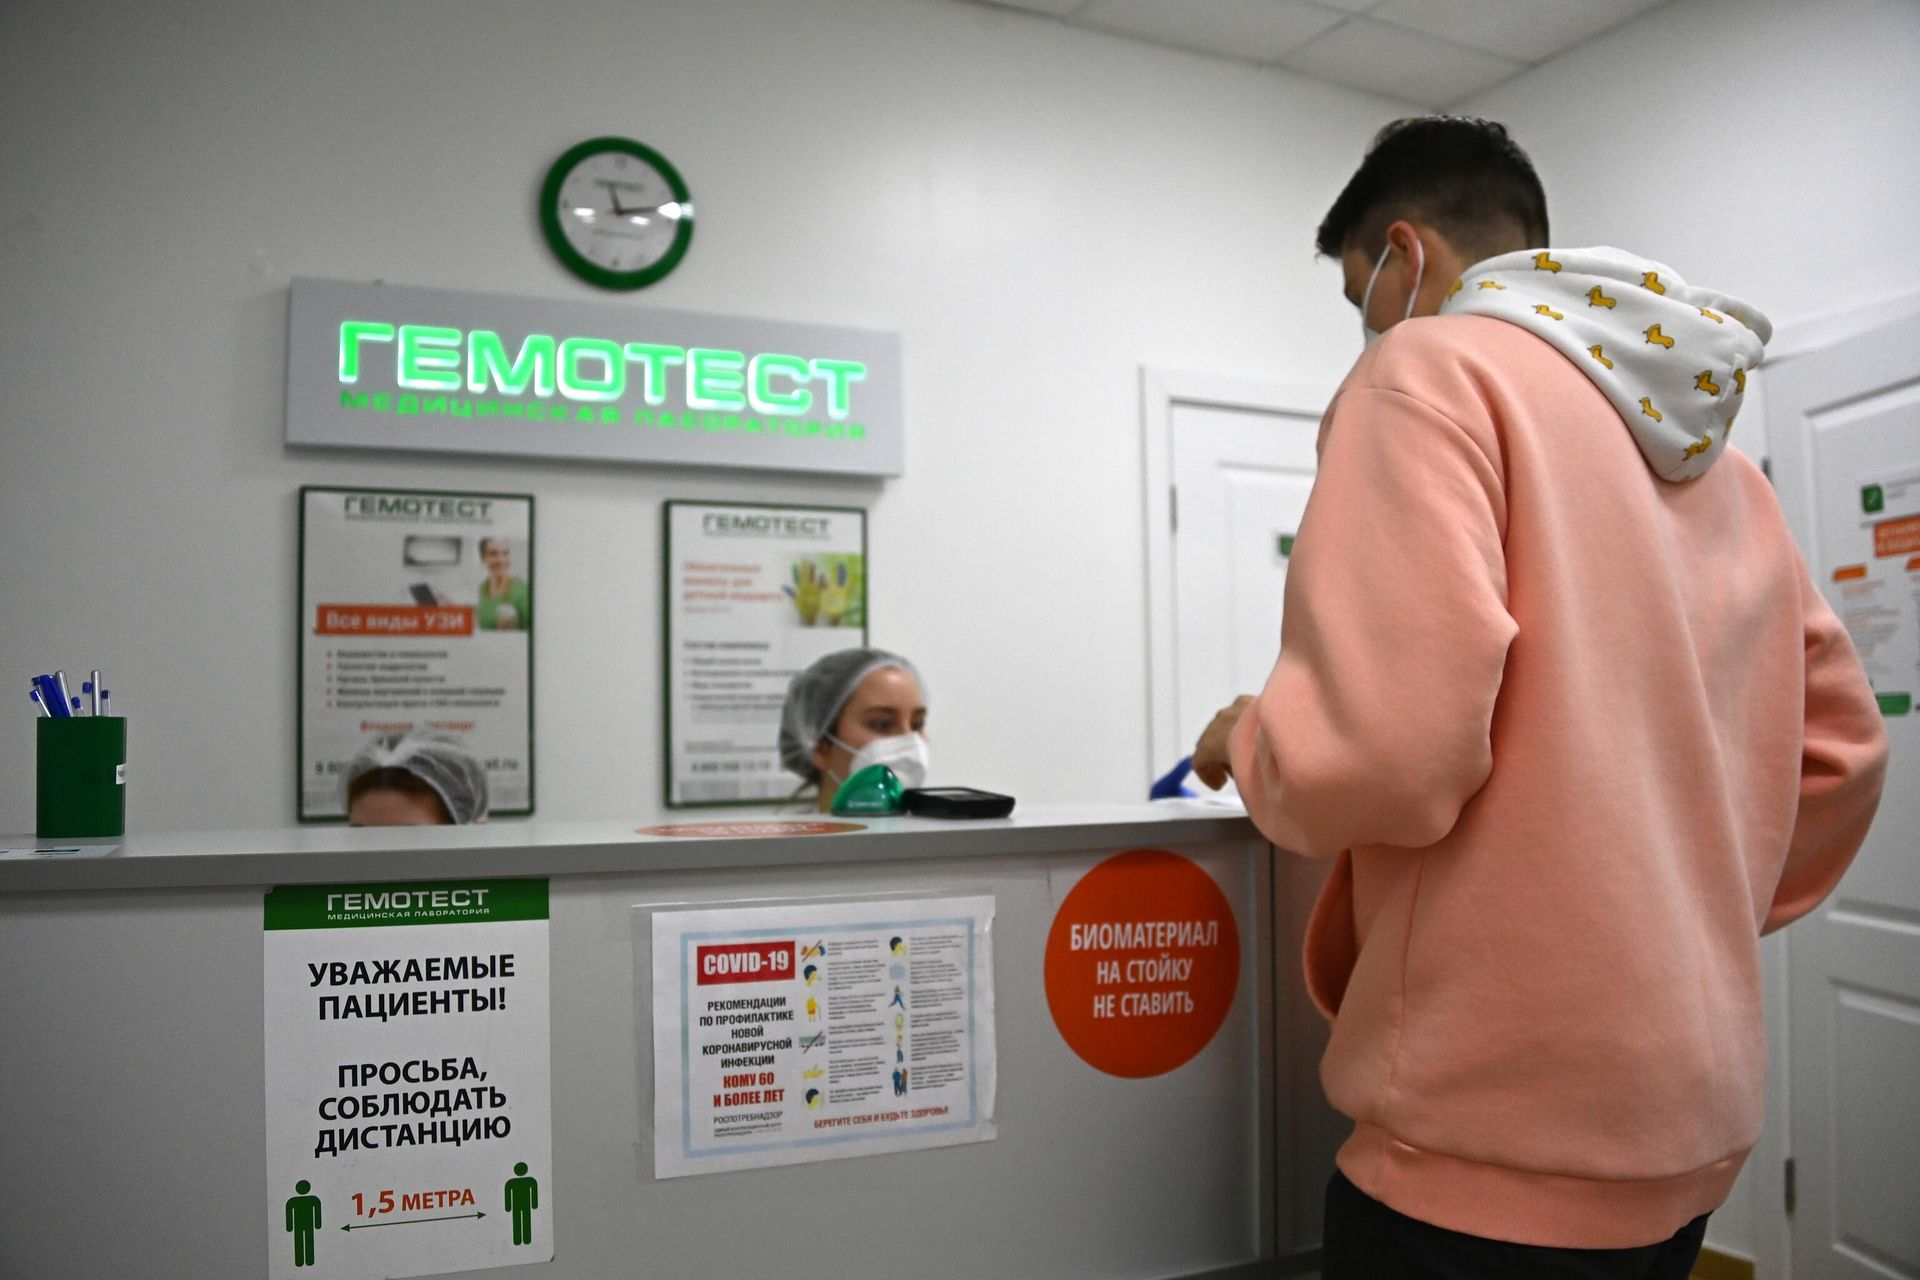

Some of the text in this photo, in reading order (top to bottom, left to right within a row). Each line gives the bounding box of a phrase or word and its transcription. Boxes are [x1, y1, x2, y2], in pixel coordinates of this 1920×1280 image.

[339, 320, 868, 421] ГЕМОТЕСТ
[340, 391, 867, 440] МЕДИЦИНСКАЯ ЛАБОРАТОРИЯ
[344, 495, 492, 518] ГЕМОТЕСТ
[702, 512, 831, 534] ГЕМОТЕСТ
[326, 610, 465, 632] Все виды УЗИ
[327, 888, 489, 912] ГЕМОТЕСТ
[327, 908, 490, 921] МЕДИЦИНСКАЯ ЛАБОРАТОРИЯ
[1070, 920, 1219, 951] БИОМАТЕРИАЛ
[307, 954, 516, 988] УВАЖАЕМЫЕ
[703, 950, 789, 976] COVID-19
[1096, 953, 1193, 985] НА СТОЙКУ
[318, 987, 507, 1022] ПАЦИЕНТЫ!
[707, 996, 787, 1012] РЕКОМЕНДАЦИИ
[1093, 991, 1194, 1018] НЕ СТАВИТЬ
[700, 1010, 795, 1027] ПО ПРОФИЛАКТИКЕ
[731, 1025, 764, 1039] НОВОЙ
[702, 1037, 792, 1056] КОРОНАВИРУСНОЙ
[337, 1057, 488, 1088] ПРОСЬБА,
[721, 1055, 775, 1069] ИНФЕКЦИИ
[723, 1072, 775, 1089] КОМУ 60
[318, 1086, 507, 1121] СОБЛЮДАТЬ
[713, 1088, 785, 1108] И БОЛЕЕ ЛЕТ
[713, 1110, 783, 1124] РОСПОТРЕБНАДЗОР
[814, 1115, 851, 1129] БЕРЕГИТЕ
[853, 1113, 873, 1125] СЕБЯ
[881, 1109, 909, 1122] БУДЬТЕ
[314, 1115, 512, 1158] ДИСТАНЦИЮ
[351, 1188, 476, 1218] 1,5 МЕТРА
